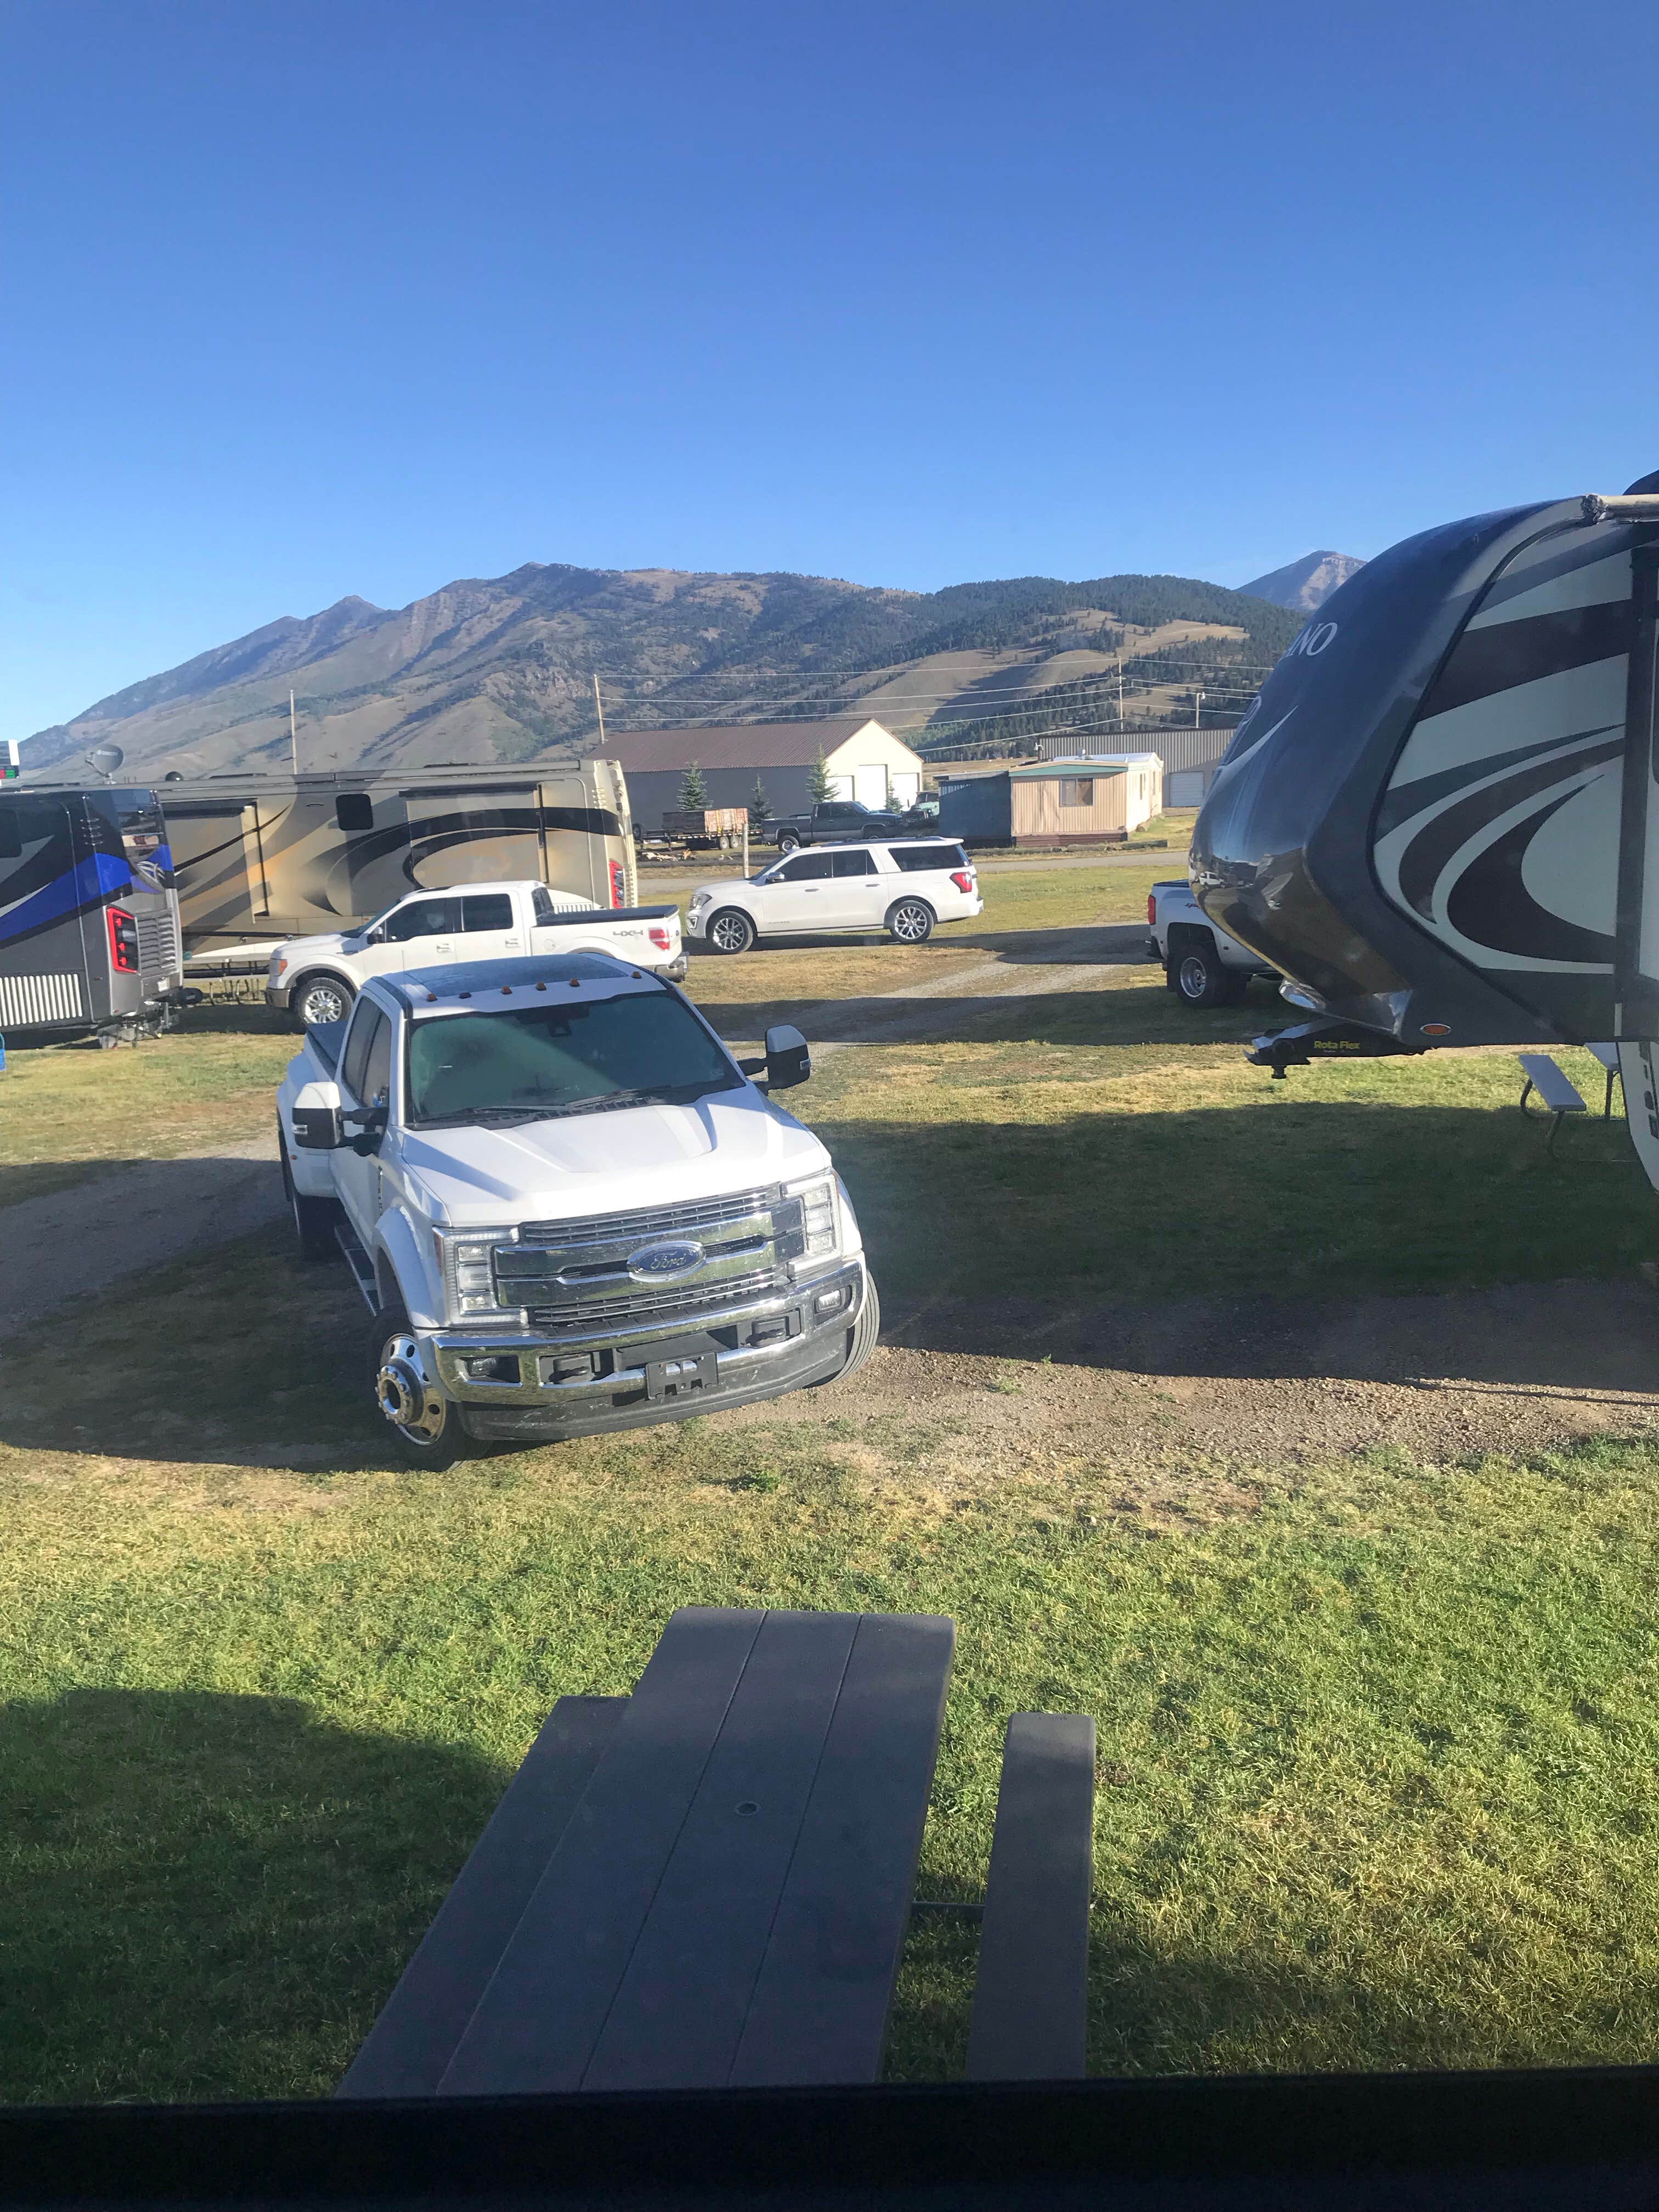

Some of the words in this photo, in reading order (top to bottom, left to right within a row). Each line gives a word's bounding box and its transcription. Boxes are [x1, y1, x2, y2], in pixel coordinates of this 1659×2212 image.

[1313, 1040, 1338, 1049] Rota
[1339, 1040, 1360, 1049] Flex
[650, 1251, 687, 1270] Ford
